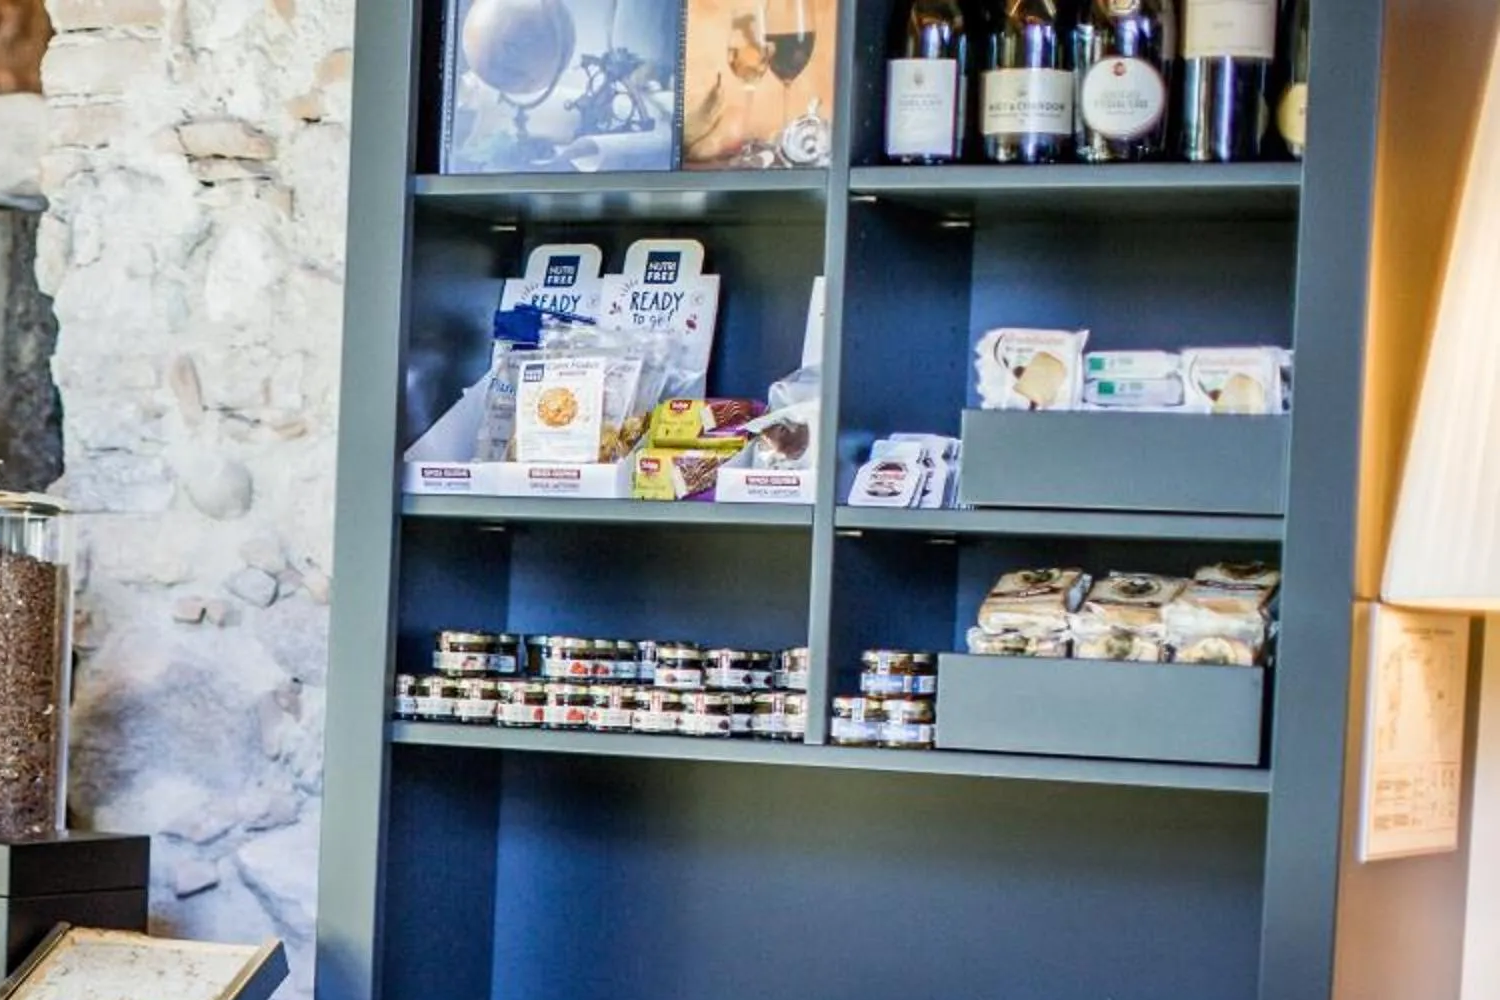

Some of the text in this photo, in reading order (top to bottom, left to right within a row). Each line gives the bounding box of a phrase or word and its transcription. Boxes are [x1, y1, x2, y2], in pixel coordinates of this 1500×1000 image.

[549, 265, 576, 275] NUTRI
[648, 261, 677, 271] NUTRI
[546, 275, 574, 285] FREE
[646, 271, 676, 281] FREE
[531, 294, 582, 313] READY
[629, 291, 685, 311] READY
